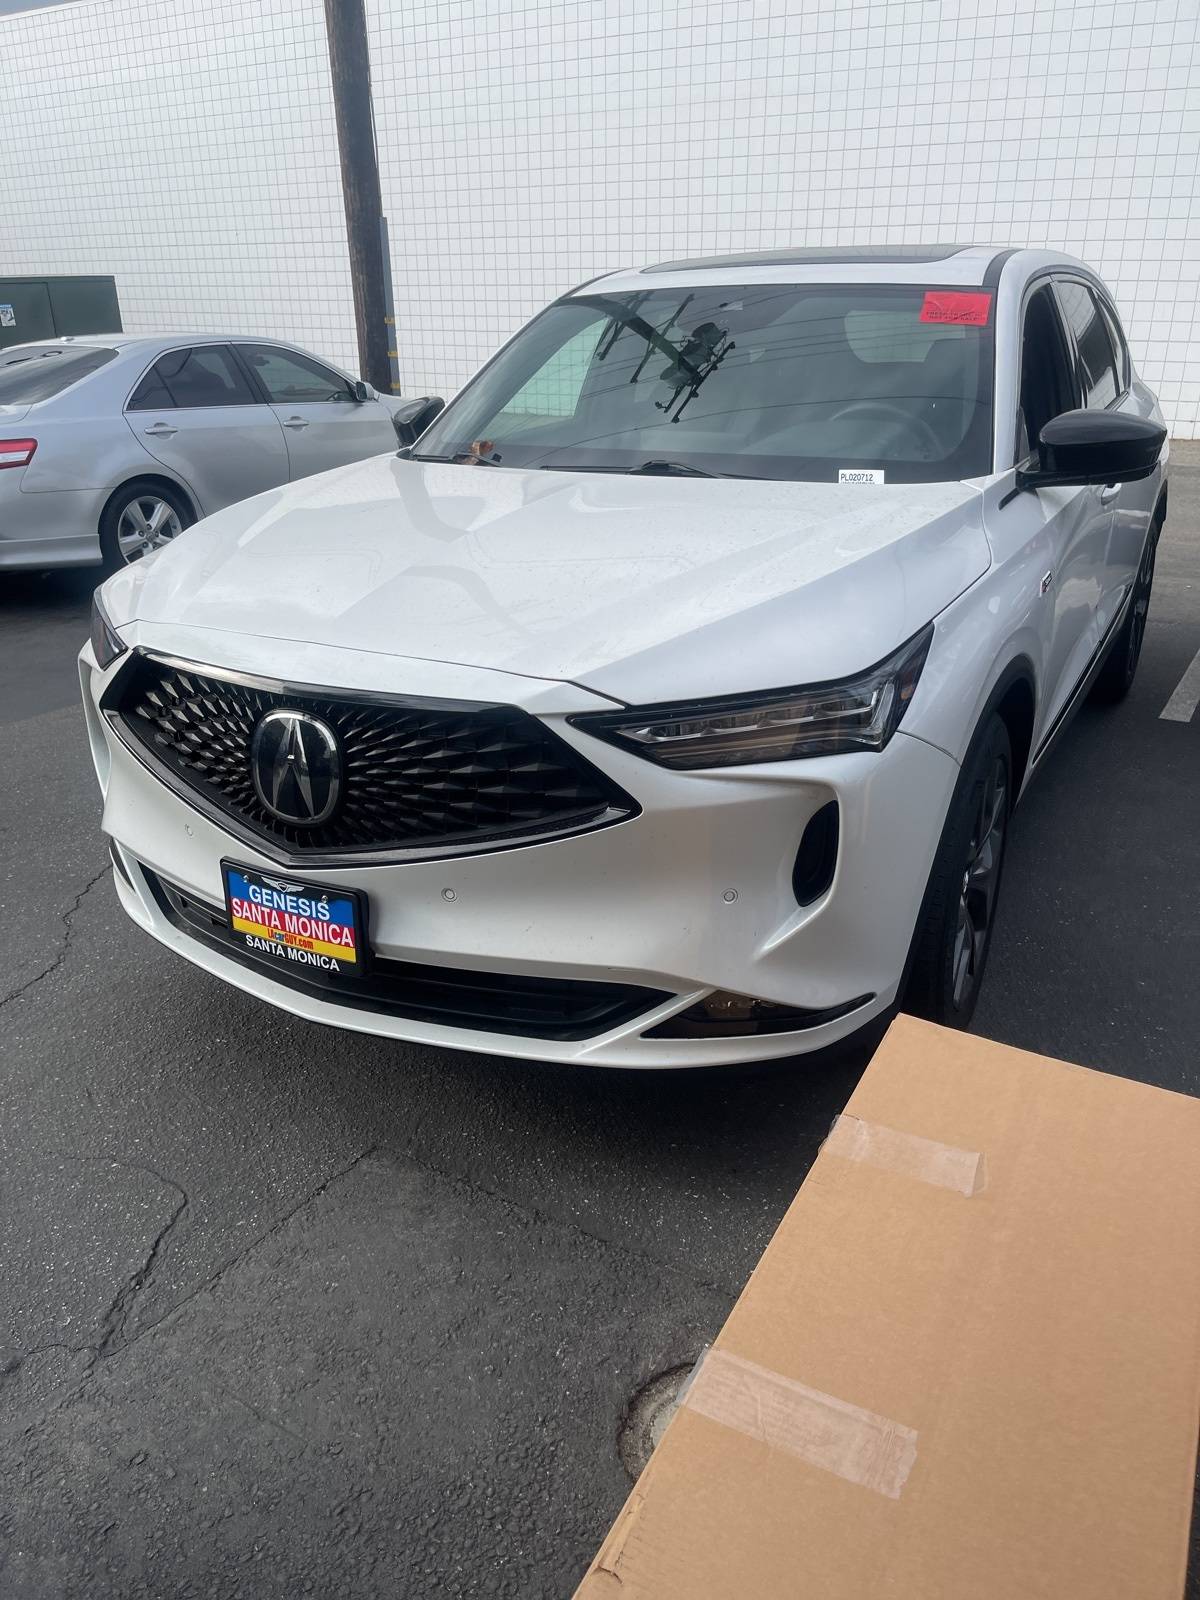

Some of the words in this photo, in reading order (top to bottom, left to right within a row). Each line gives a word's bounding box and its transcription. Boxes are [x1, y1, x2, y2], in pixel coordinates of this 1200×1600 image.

[840, 473, 874, 482] PL020712
[248, 885, 331, 921] GENESIS
[232, 898, 282, 930] SANTA
[284, 913, 354, 948] MONICA
[245, 934, 286, 958] SANTA
[287, 947, 341, 972] MONICA
